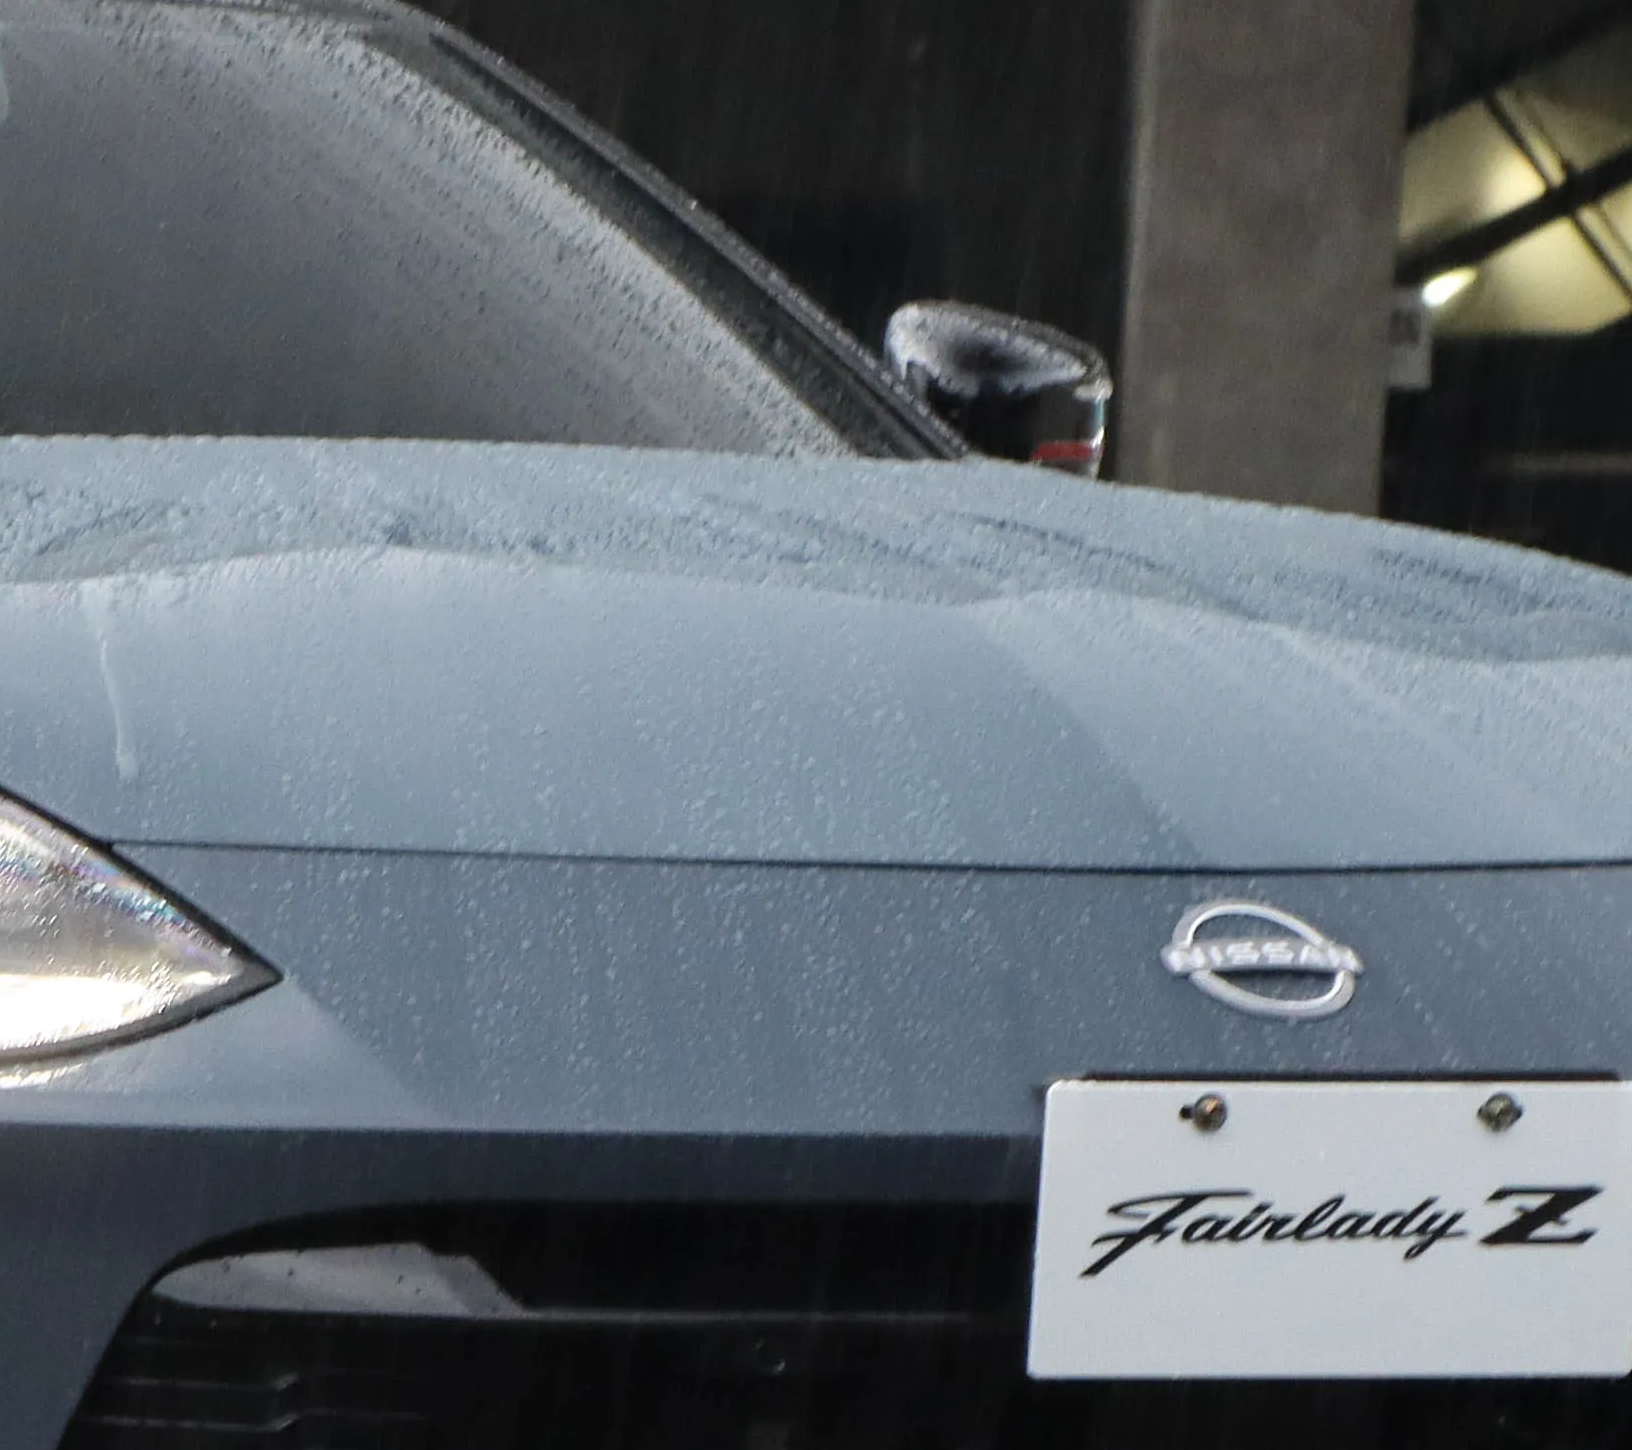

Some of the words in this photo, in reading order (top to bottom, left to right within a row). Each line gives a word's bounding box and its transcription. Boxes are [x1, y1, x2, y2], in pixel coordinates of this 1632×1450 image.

[1168, 940, 1360, 972] NISSAN
[1079, 1188, 1470, 1279] Fairlady
[1479, 1184, 1603, 1245] Z
